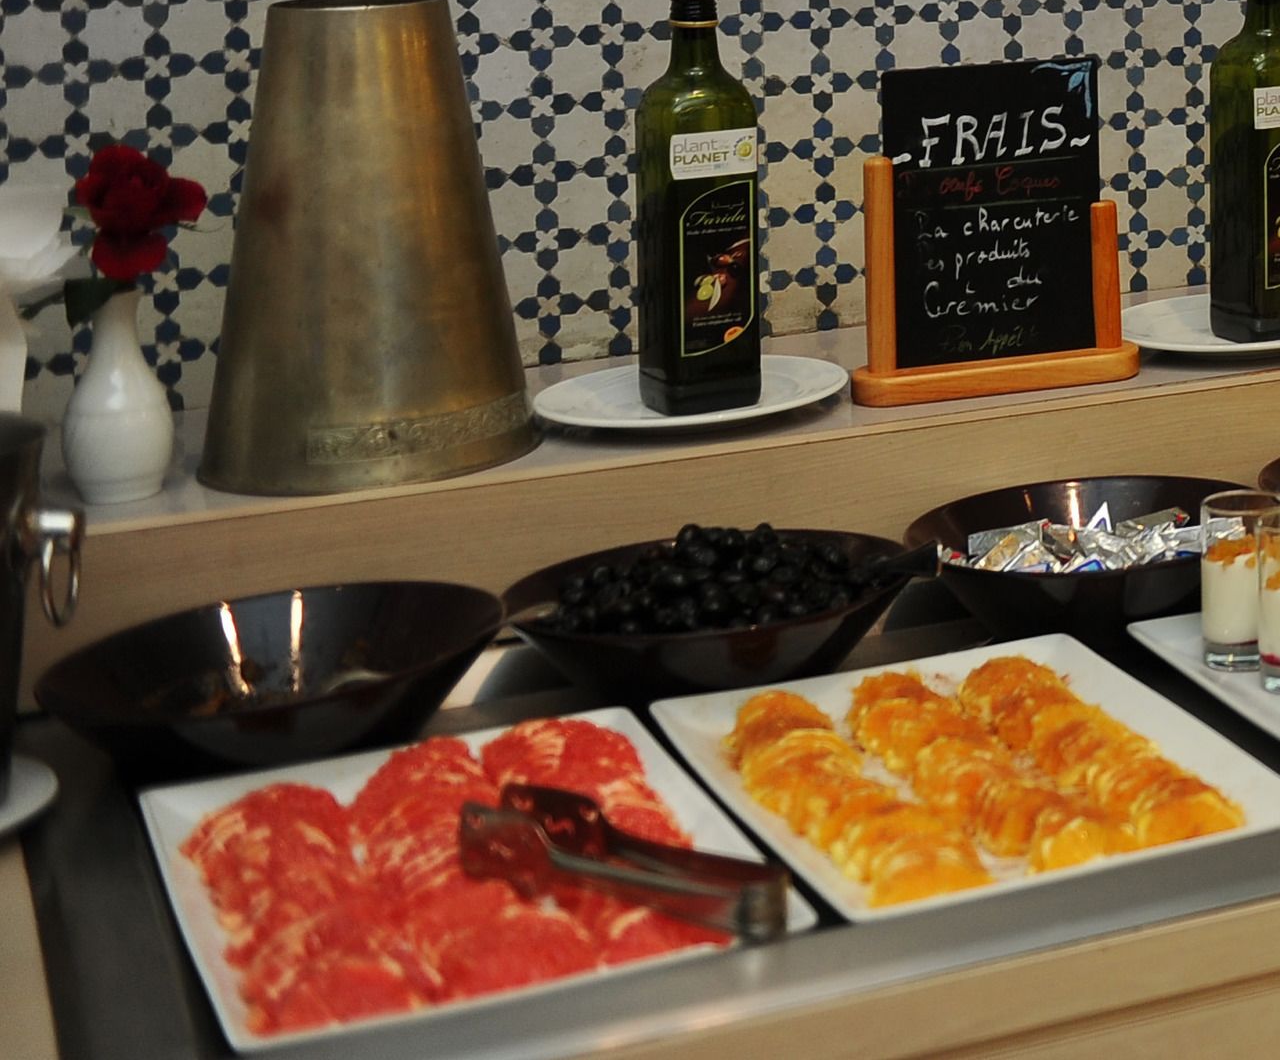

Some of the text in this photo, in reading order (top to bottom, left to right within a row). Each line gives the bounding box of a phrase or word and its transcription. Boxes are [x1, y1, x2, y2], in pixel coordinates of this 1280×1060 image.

[672, 138, 718, 157] plant
[673, 151, 730, 166] PLANET
[686, 205, 747, 227] Farida
[963, 203, 1080, 236] charcuterie
[955, 237, 1031, 281] produits
[1006, 265, 1043, 289] du
